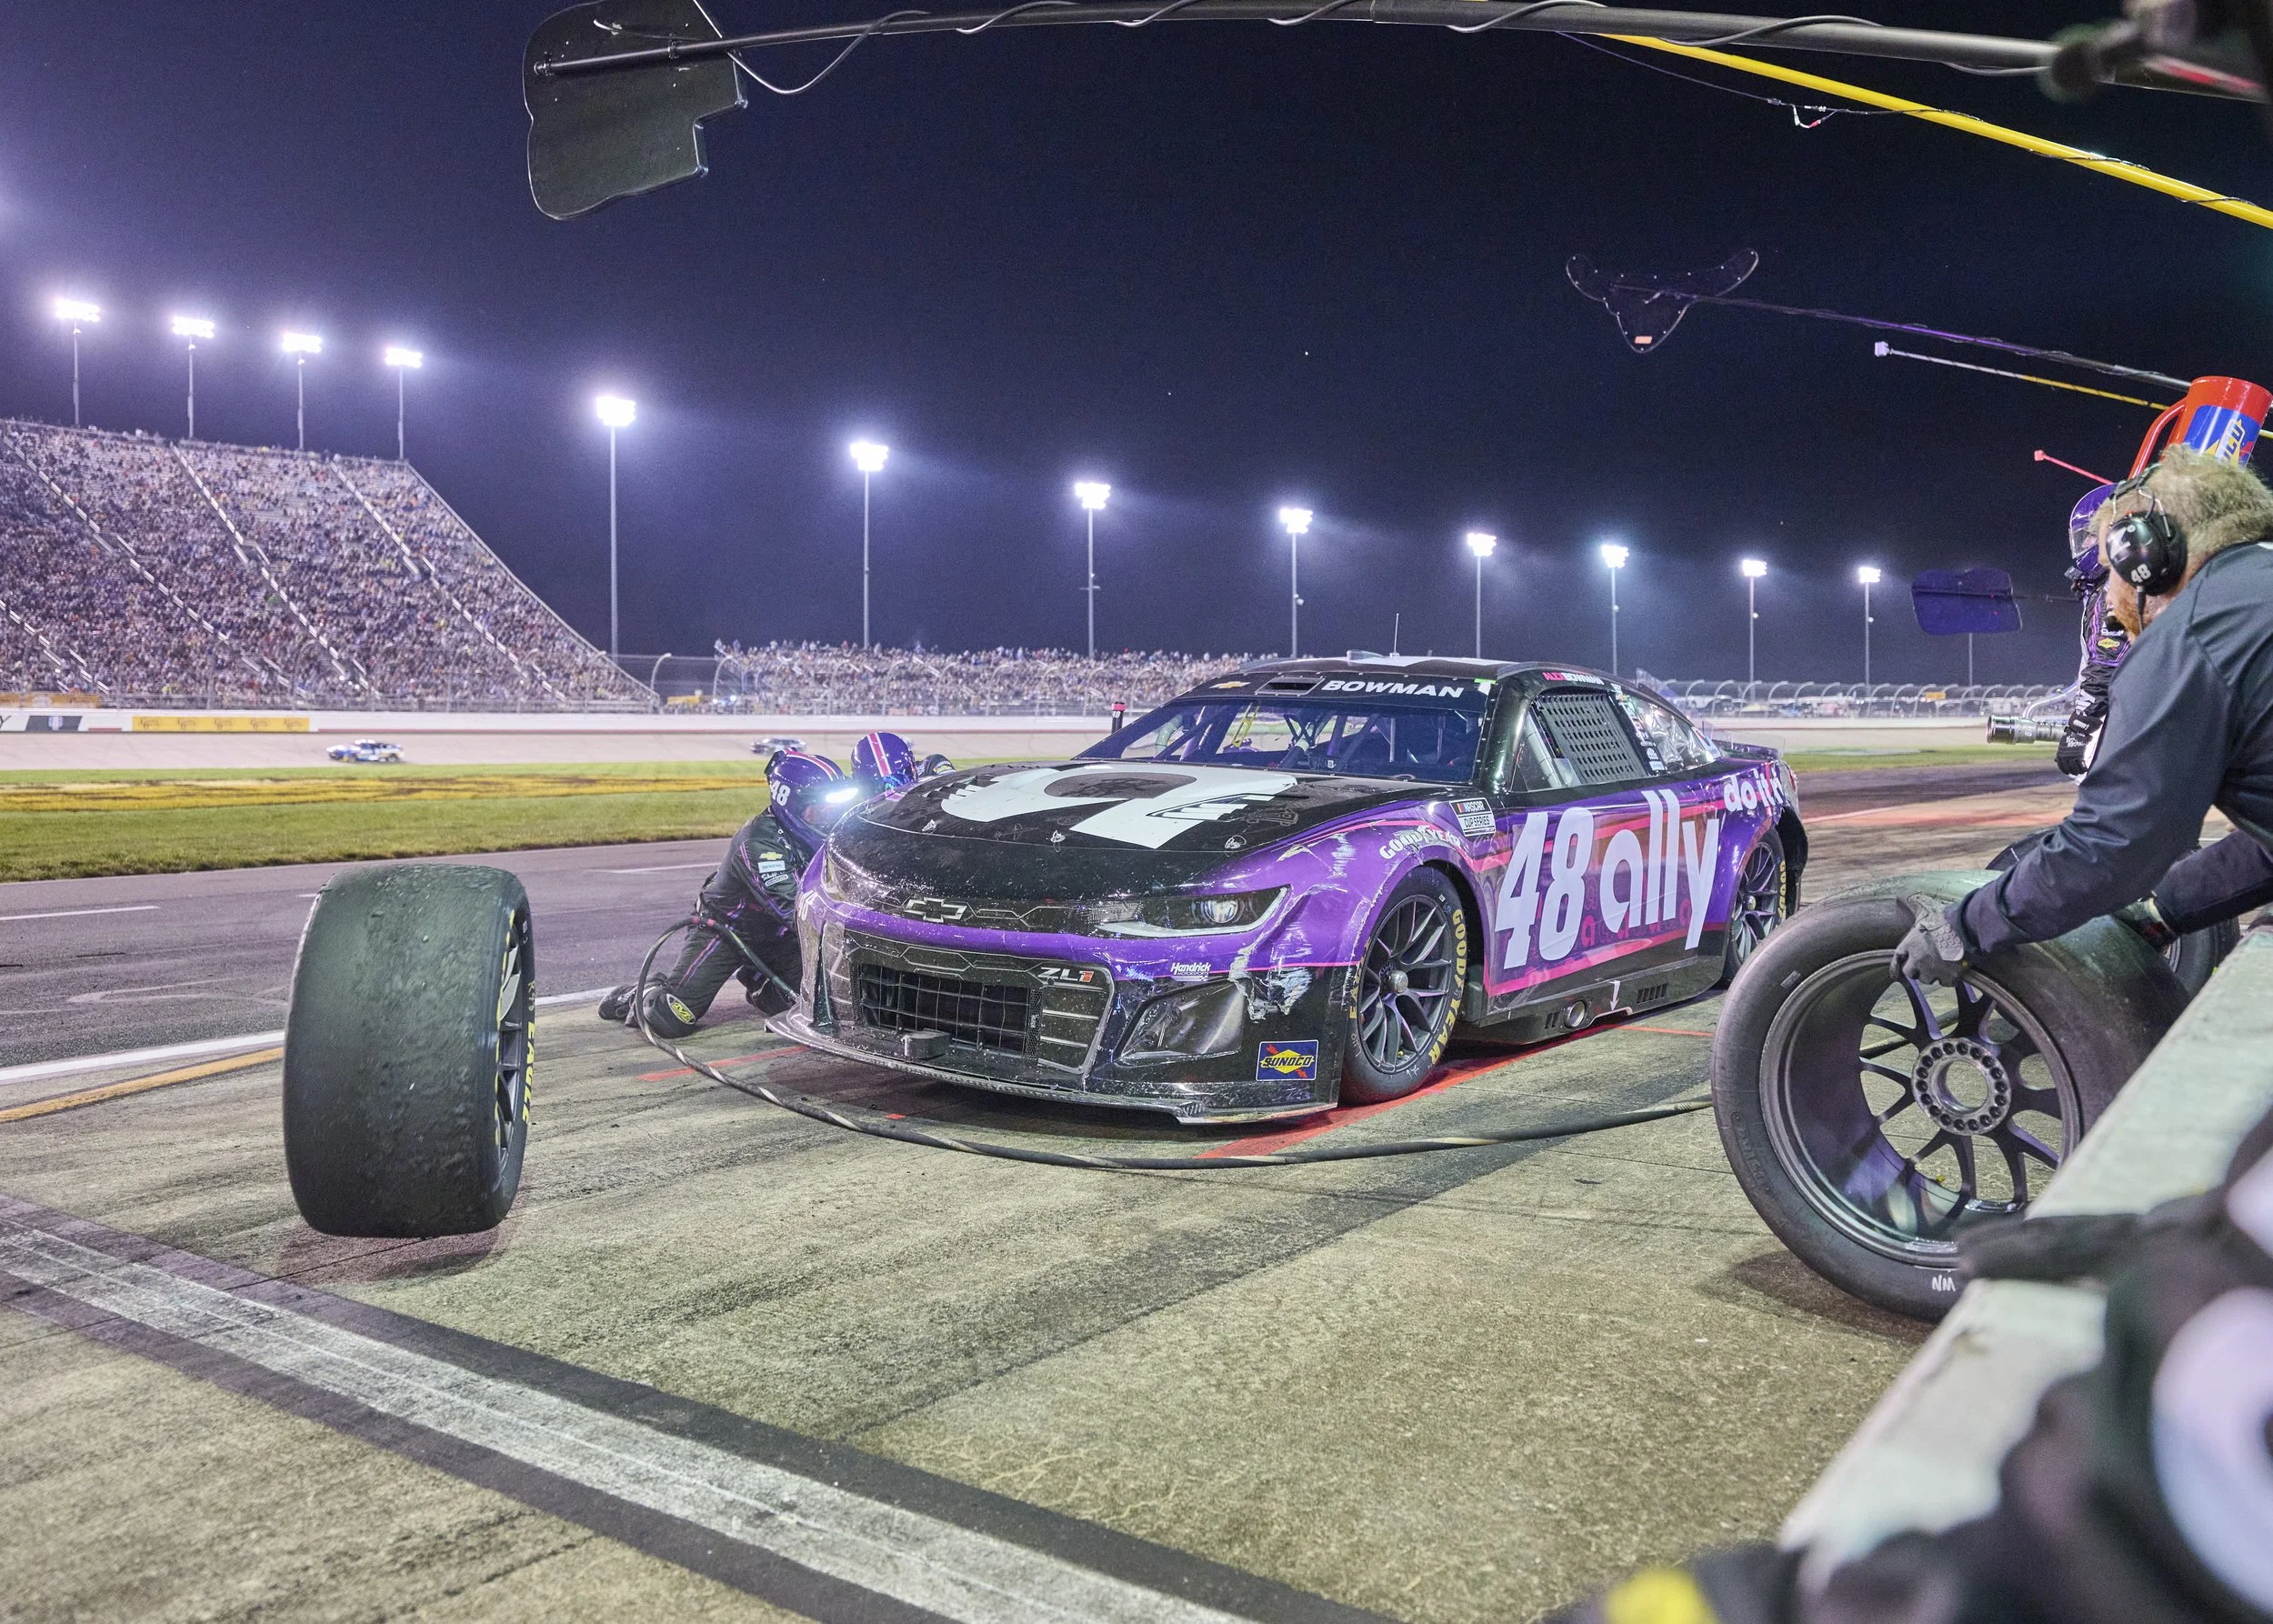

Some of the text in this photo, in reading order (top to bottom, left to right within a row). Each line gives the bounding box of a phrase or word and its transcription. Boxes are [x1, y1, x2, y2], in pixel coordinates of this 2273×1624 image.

[2131, 564, 2151, 582] 48
[1321, 680, 1464, 698] BOWMAN
[771, 780, 791, 807] 48
[1724, 775, 1757, 812] do
[1753, 767, 1776, 807] it
[1464, 801, 1486, 812] NASCAR
[1464, 816, 1490, 827] CUP SERIES
[1495, 788, 1719, 970] 48 ally
[1037, 967, 1095, 983] ZL1
[1170, 962, 1212, 975] Hendrick
[1428, 909, 1467, 1065] GOODYEAR
[1262, 1056, 1313, 1068] SUNOCO
[522, 1021, 536, 1126] EAGLE
